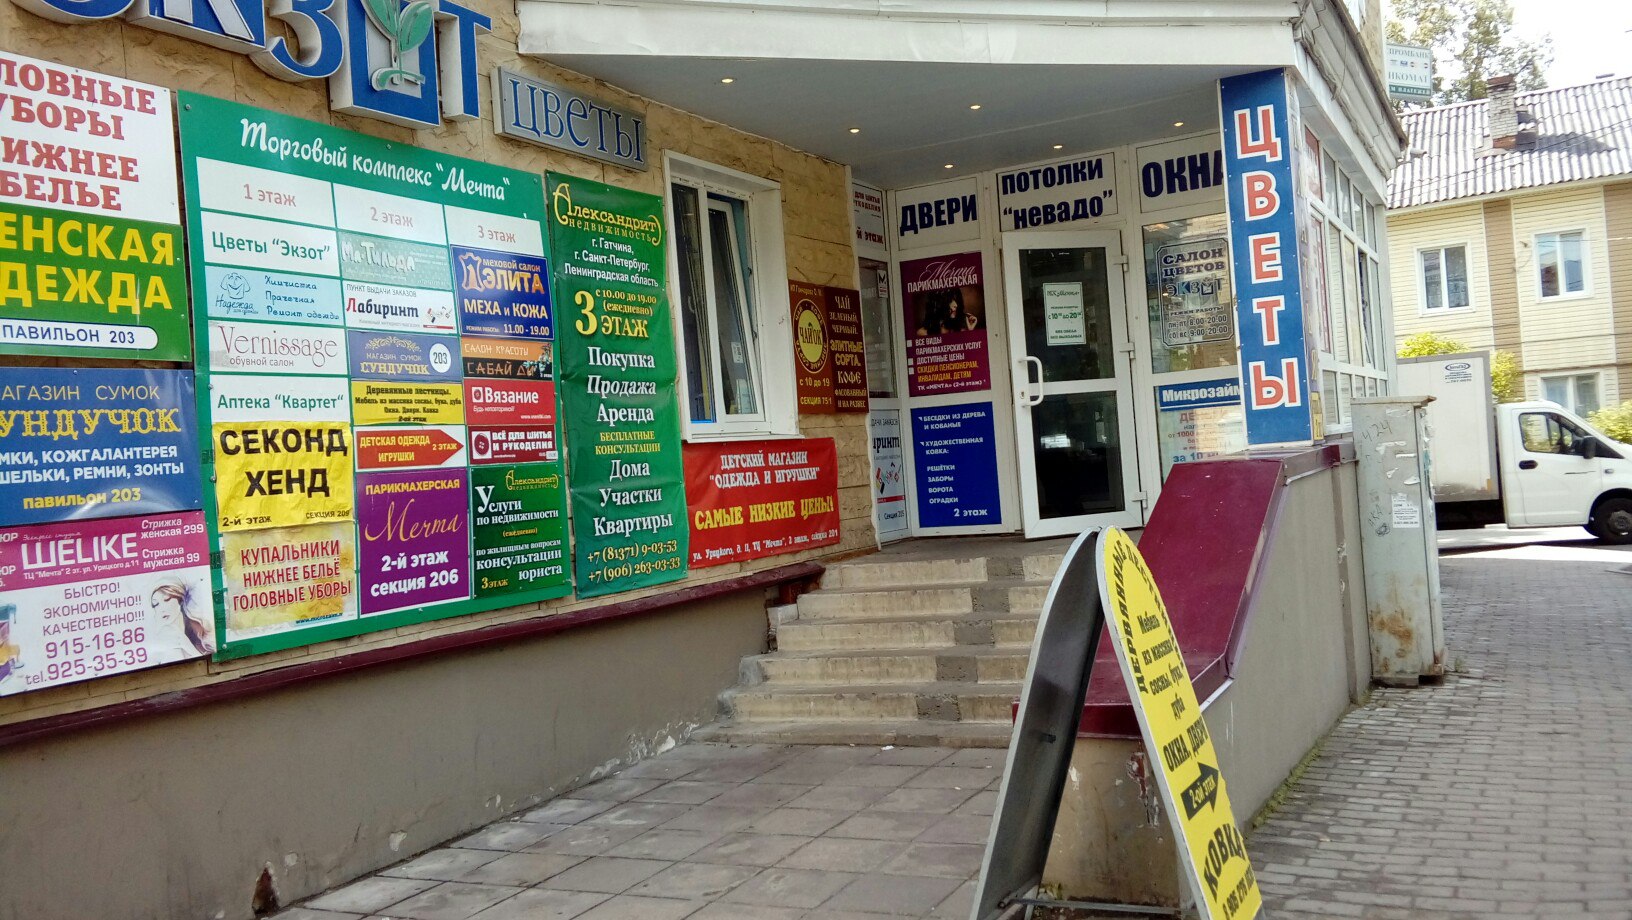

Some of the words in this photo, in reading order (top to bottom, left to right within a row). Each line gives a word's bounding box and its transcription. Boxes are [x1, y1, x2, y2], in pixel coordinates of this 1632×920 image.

[508, 78, 644, 163] ЦВЕТЫ
[0, 136, 139, 182] ИЖНЕЕ
[240, 118, 347, 168] Торговый
[353, 155, 432, 186] комплекс
[1001, 158, 1103, 195] ПОТОЛКИ
[0, 170, 121, 211] БЕЛЬЕ
[553, 183, 662, 246] Александрит
[899, 194, 978, 237] ДВЕРИ
[0, 212, 173, 266] ЕНСКАЯ
[569, 219, 652, 242] недвижимость
[212, 231, 267, 253] Цветы
[600, 238, 634, 255] Гатчина,
[582, 251, 650, 272] Санкт-Петербург,
[1162, 248, 1224, 265] САЛОН
[1234, 104, 1301, 411] ЦВЕТЫ
[564, 263, 629, 282] Ленинградская
[631, 275, 659, 288] область
[1163, 261, 1225, 278] ЦВЕТОВ
[0, 262, 172, 314] ДЕЖДА
[482, 268, 545, 294] ЭЛИТА
[908, 274, 978, 293] ПАРИКМАХЕРСКАЯ
[215, 294, 254, 314] Надежда
[346, 297, 419, 319] Лабиринт
[464, 299, 501, 315] МЕХА
[512, 303, 548, 319] КОЖА
[835, 295, 851, 309] ЧАЙ
[574, 290, 598, 336] 3
[1170, 308, 1194, 317] РЕЖИМ
[3, 325, 99, 343] ПАВИЛЬОН
[109, 330, 135, 344] 203
[504, 324, 524, 334] 11.00
[530, 326, 549, 336] 19.00
[601, 315, 649, 338] ЭТАЖ
[218, 326, 338, 367] Vernissage
[464, 343, 492, 354] САЛОН
[495, 346, 528, 356] КРАСОТЫ
[830, 340, 864, 353] ЭЛИТНЫЕ
[915, 338, 925, 347] ВСЕ
[926, 337, 942, 345] ВИДЫ
[915, 343, 964, 355] ПАРИКМАХЕРСКИХ
[965, 341, 982, 350] УСЛУГ
[230, 356, 266, 366] обувной
[269, 358, 294, 366] салон
[433, 352, 448, 364] 203
[587, 346, 655, 371] Покупка
[917, 355, 948, 365] ДОСТУПНЫЕ
[949, 353, 965, 362] ЦЕНЫ
[360, 362, 430, 375] СУНДУЧОК
[467, 361, 512, 375] САБАЙ
[837, 371, 862, 384] КОФЕ
[917, 364, 938, 374] СКИДКИ
[953, 370, 971, 379] ДЕТЯМ
[587, 375, 656, 399] Продажа
[805, 377, 812, 386] 10
[823, 378, 830, 386] 19
[2, 385, 80, 400] АГАЗИН
[95, 385, 160, 400] СУМОК
[217, 394, 270, 409] Аптека
[485, 387, 539, 403] Вязание
[800, 397, 821, 406] СЕКЦИЯ
[0, 407, 181, 440] УНДУЧОК
[597, 403, 654, 427] Аренда
[923, 414, 951, 422] БЕСЕДКИ
[962, 411, 986, 419] ДЕРЕВА
[219, 428, 348, 457] СЕКОНД
[360, 437, 396, 448] ДЕТСКАЯ
[398, 436, 430, 446] ОДЕЖДА
[503, 441, 552, 451] РУКОДЕЛИЯ
[508, 432, 525, 441] ДЛЯ
[600, 431, 655, 442] БЕСПЛАТНЫЕ
[925, 437, 984, 447] ХУДОЖЕСТВЕННАЯ
[42, 446, 177, 464] КОЖГАЛАНТЕРЕЯ
[378, 452, 415, 462] ИГРУШКИ
[595, 443, 661, 455] КОНСУЛЬТАЦИИ
[720, 450, 765, 470] ДЕТСКИЙ
[768, 451, 808, 466] МАГАЗИН
[74, 465, 131, 480] РЕМНИ,
[134, 462, 184, 475] ЗОНТЫ
[505, 469, 558, 491] Александрит
[610, 459, 650, 482] Дома
[764, 470, 771, 484] И
[245, 468, 330, 498] ХЕНД
[365, 479, 460, 495] ПАРИКМАХЕРСКАЯ
[23, 492, 107, 509] павильон
[111, 488, 141, 502] 203
[475, 485, 522, 514] Услуги
[599, 488, 662, 507] Участки
[306, 511, 335, 519] СЕКЦИЯ
[364, 498, 463, 542] Мечта
[491, 510, 559, 524] недвижимости
[694, 505, 744, 530] САМЫЕ
[749, 500, 796, 523] НИЗКИЕ
[800, 495, 834, 520] ЦЕНЫ!
[141, 529, 182, 539] женская
[183, 524, 204, 534] 299
[142, 519, 182, 530] Стрижка
[593, 514, 673, 537] Квартиры
[142, 546, 184, 559] Стрижка
[241, 540, 340, 566] КУПАЛЬНИКИ
[476, 549, 562, 570] консультации
[603, 543, 639, 562] (81371)
[642, 539, 677, 555] 9-03-53
[143, 556, 185, 569] мужская
[187, 552, 200, 562] 99
[381, 553, 407, 572] 2-й
[603, 563, 632, 581] (906)
[634, 557, 680, 574] 263-03-33
[243, 566, 299, 588] НИЖНЕЕ
[303, 558, 340, 580] БЕЛЬЁ
[370, 576, 426, 597] секция
[429, 568, 459, 587] 206
[518, 565, 563, 582] юриста
[64, 582, 120, 599] БЫСТРО!
[233, 586, 305, 611] ГОЛОВНЫЕ
[308, 580, 351, 600] УБОРЫ
[43, 596, 142, 619] ЭКОНОМИЧНО!!
[43, 611, 145, 636] КАЧЕСТВЕННО!!!
[46, 627, 145, 659] 915-16-86
[1203, 823, 1247, 904] КОВКА
